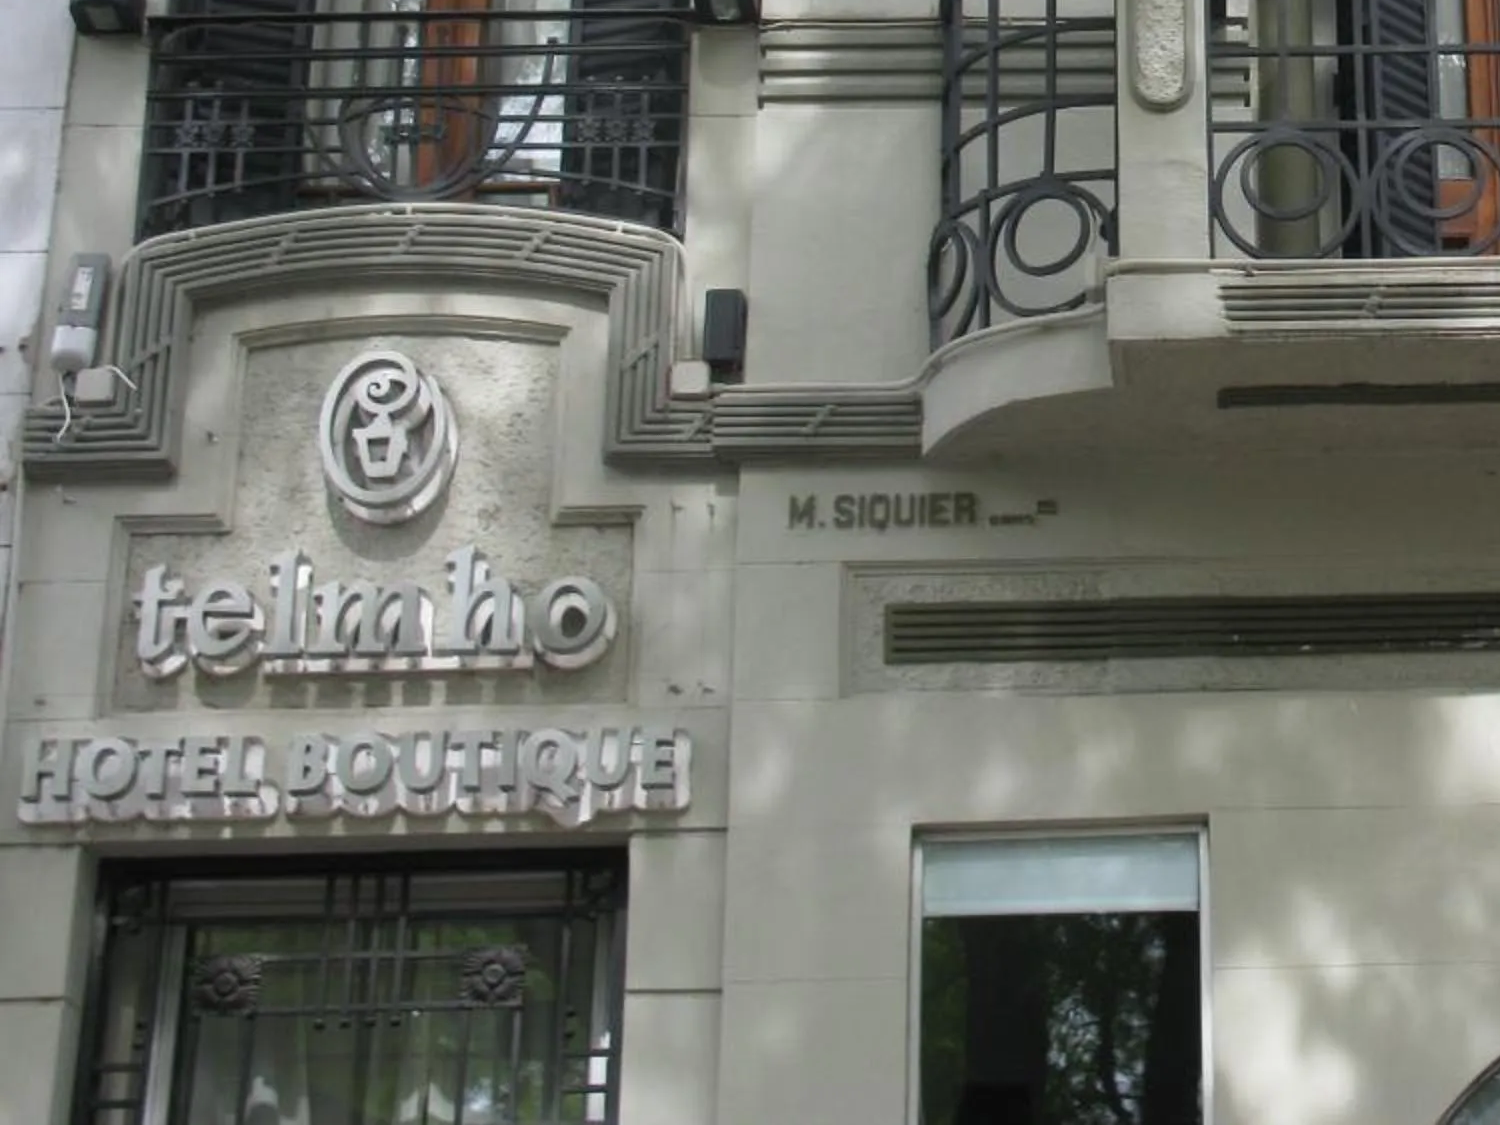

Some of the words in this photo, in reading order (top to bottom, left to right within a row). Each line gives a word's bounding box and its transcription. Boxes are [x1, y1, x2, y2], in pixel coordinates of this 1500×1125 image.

[134, 546, 615, 672] telmho
[18, 736, 274, 813] HOTEL
[287, 728, 686, 815] BOUTIQUE
